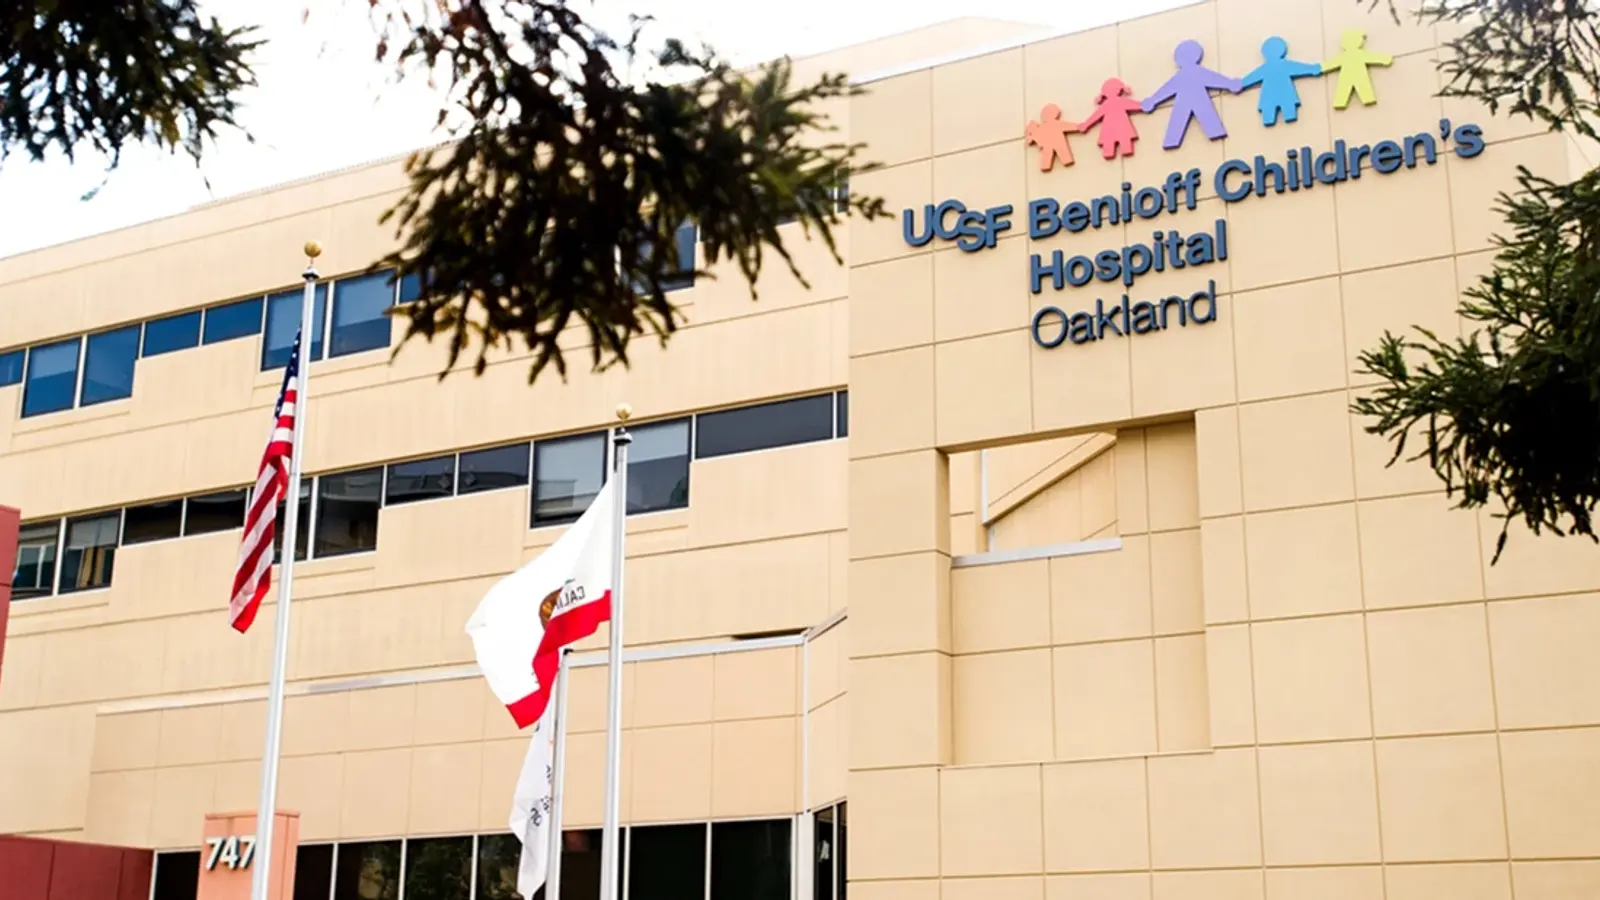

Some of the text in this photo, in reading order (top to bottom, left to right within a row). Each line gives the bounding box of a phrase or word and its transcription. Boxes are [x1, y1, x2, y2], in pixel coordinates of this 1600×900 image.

[903, 117, 1486, 252] UCSF Benioff Children's
[1030, 219, 1228, 294] Hospital
[1031, 280, 1218, 348] Oakland
[205, 835, 257, 871] 747
